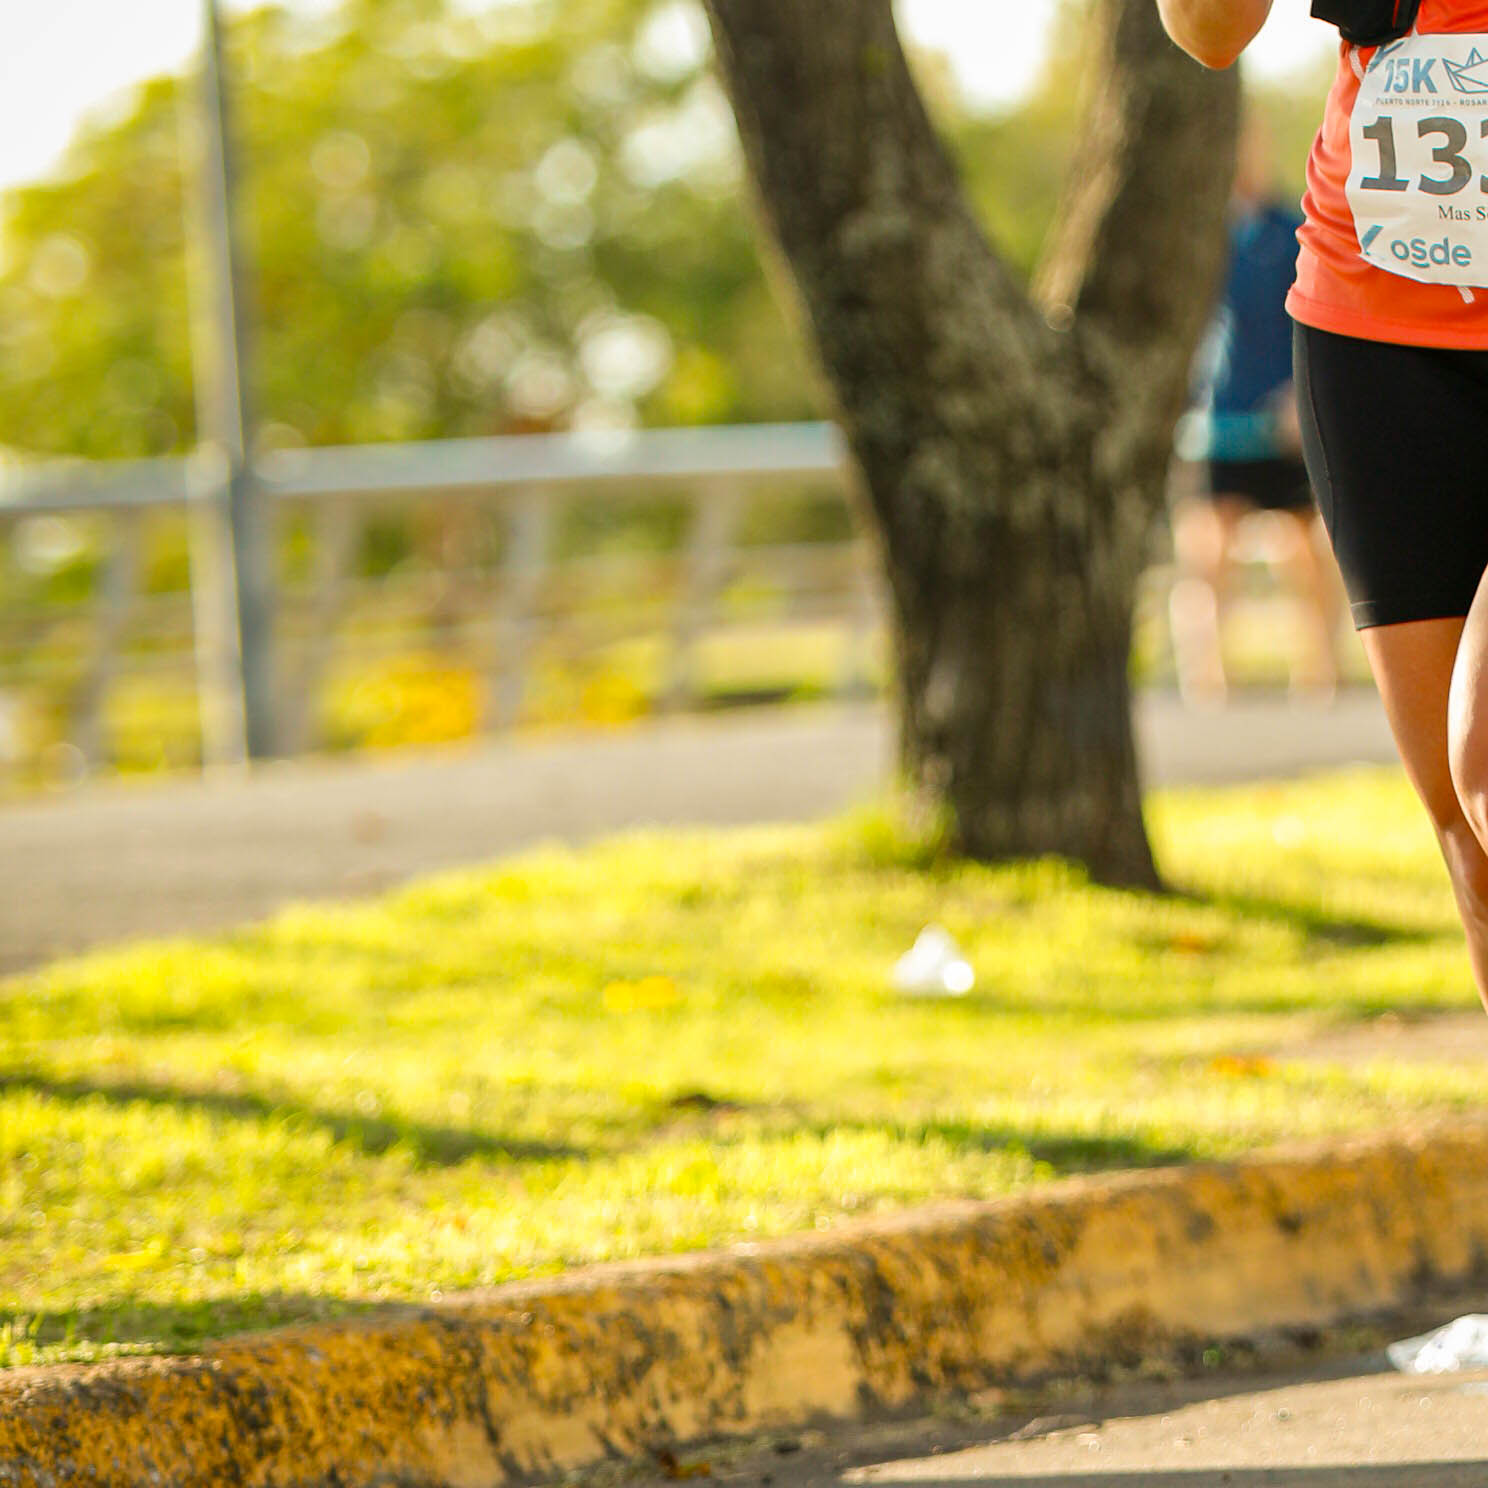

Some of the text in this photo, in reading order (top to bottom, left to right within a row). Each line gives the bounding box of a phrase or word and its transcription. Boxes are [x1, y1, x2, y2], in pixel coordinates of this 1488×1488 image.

[1383, 57, 1438, 94] 15K
[1437, 204, 1471, 221] Mas
[1390, 237, 1472, 268] osde
